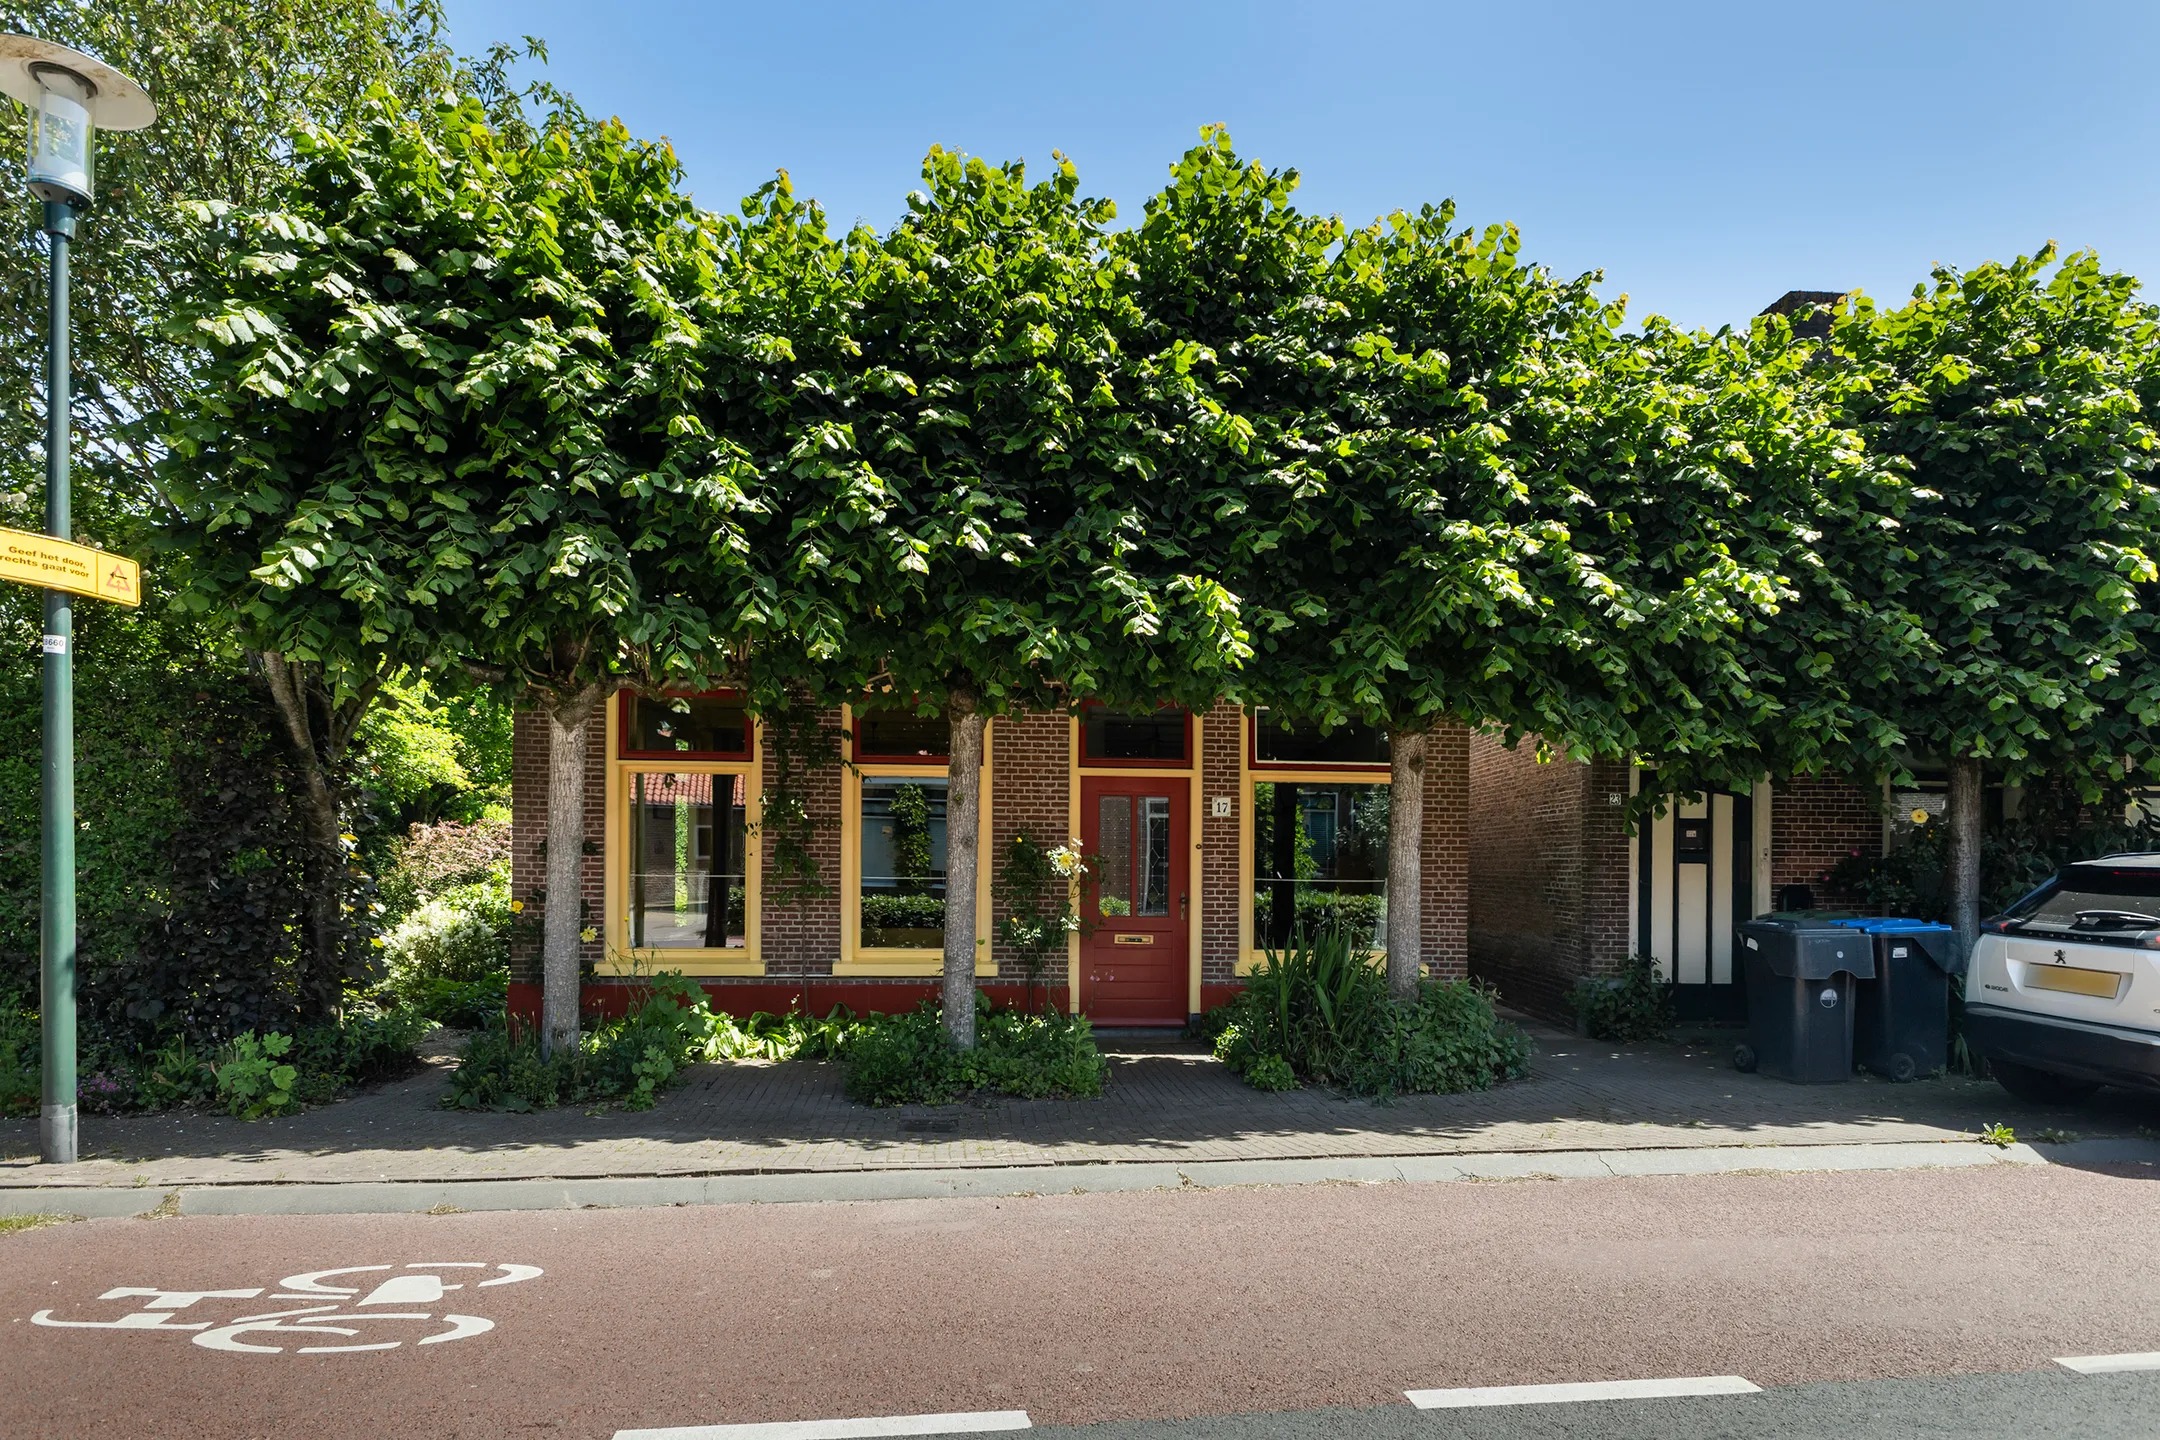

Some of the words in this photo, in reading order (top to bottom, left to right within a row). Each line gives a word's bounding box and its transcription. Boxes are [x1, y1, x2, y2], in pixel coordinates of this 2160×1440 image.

[8, 545, 37, 557] Geef
[40, 551, 59, 562] het
[62, 557, 86, 569] door,
[0, 555, 38, 567] rechts
[41, 563, 67, 573] gaat
[69, 568, 90, 578] voor
[1610, 793, 1621, 804] 23
[1216, 802, 1228, 813] 17
